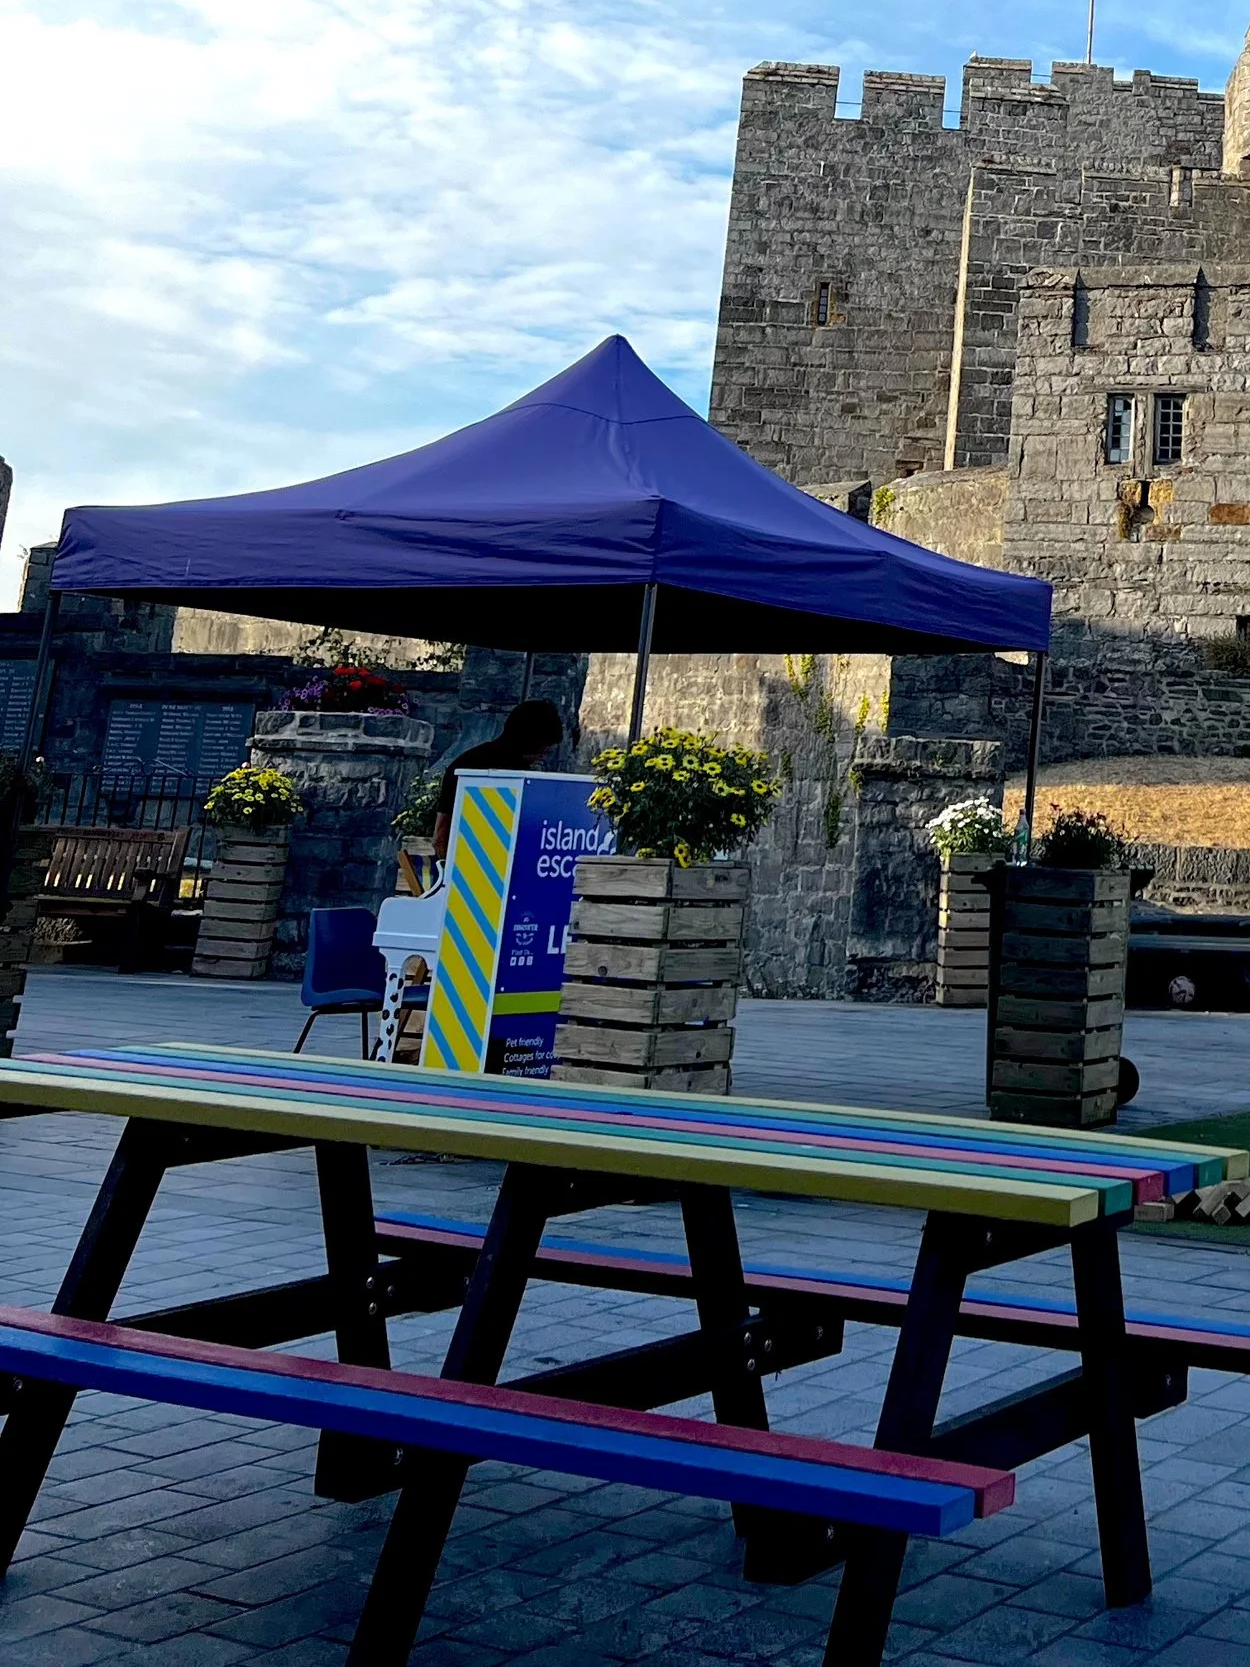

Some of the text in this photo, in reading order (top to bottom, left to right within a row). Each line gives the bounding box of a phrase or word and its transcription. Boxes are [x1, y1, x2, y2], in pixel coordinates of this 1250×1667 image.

[540, 819, 600, 852] island
[505, 1036, 544, 1048] Pet friendly
[504, 1052, 534, 1064] Cottages
[524, 1064, 549, 1076] friendly
